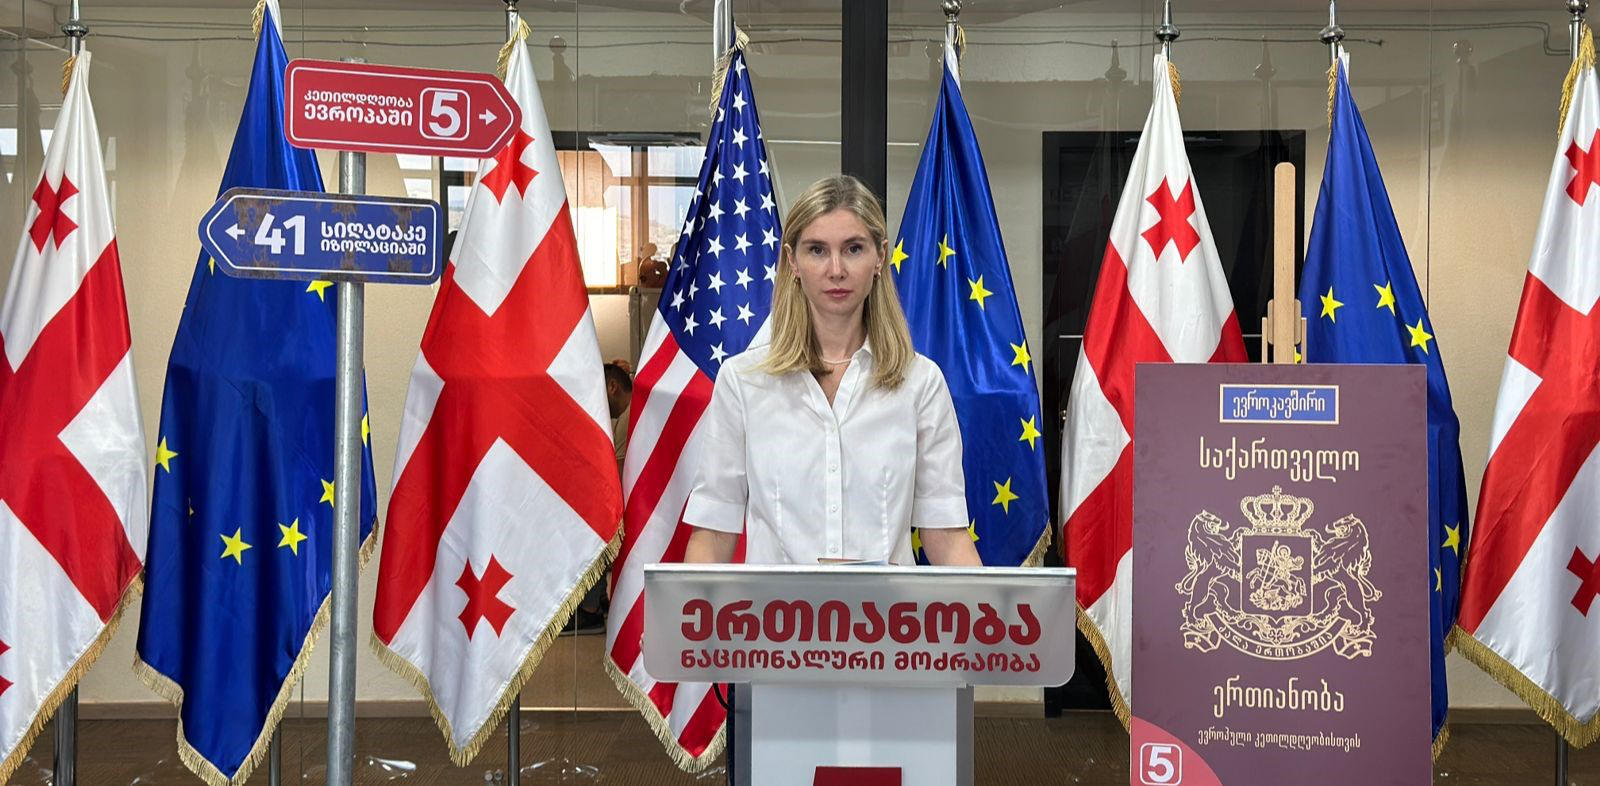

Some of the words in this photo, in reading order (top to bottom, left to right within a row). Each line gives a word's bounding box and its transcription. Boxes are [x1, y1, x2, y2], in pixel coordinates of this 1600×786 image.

[304, 89, 413, 108] კეთილდღეობა
[304, 103, 413, 126] ევროპაში
[429, 92, 461, 136] 5
[254, 212, 306, 255] 41
[321, 221, 427, 242] სიღატაკე
[321, 239, 427, 256] იზოლაციაში
[1233, 389, 1325, 419] ევროკავშირი
[1200, 436, 1360, 483] საქართველო
[681, 598, 1042, 646] ერთიანობა
[681, 648, 885, 671] ნაციონალური
[895, 650, 1041, 672] მოძრაობა
[1213, 675, 1344, 718] ერთიანობა
[1198, 726, 1252, 746] ევროპული
[1254, 732, 1361, 752] კეთილდღეობისთვის
[1147, 746, 1175, 783] 5
